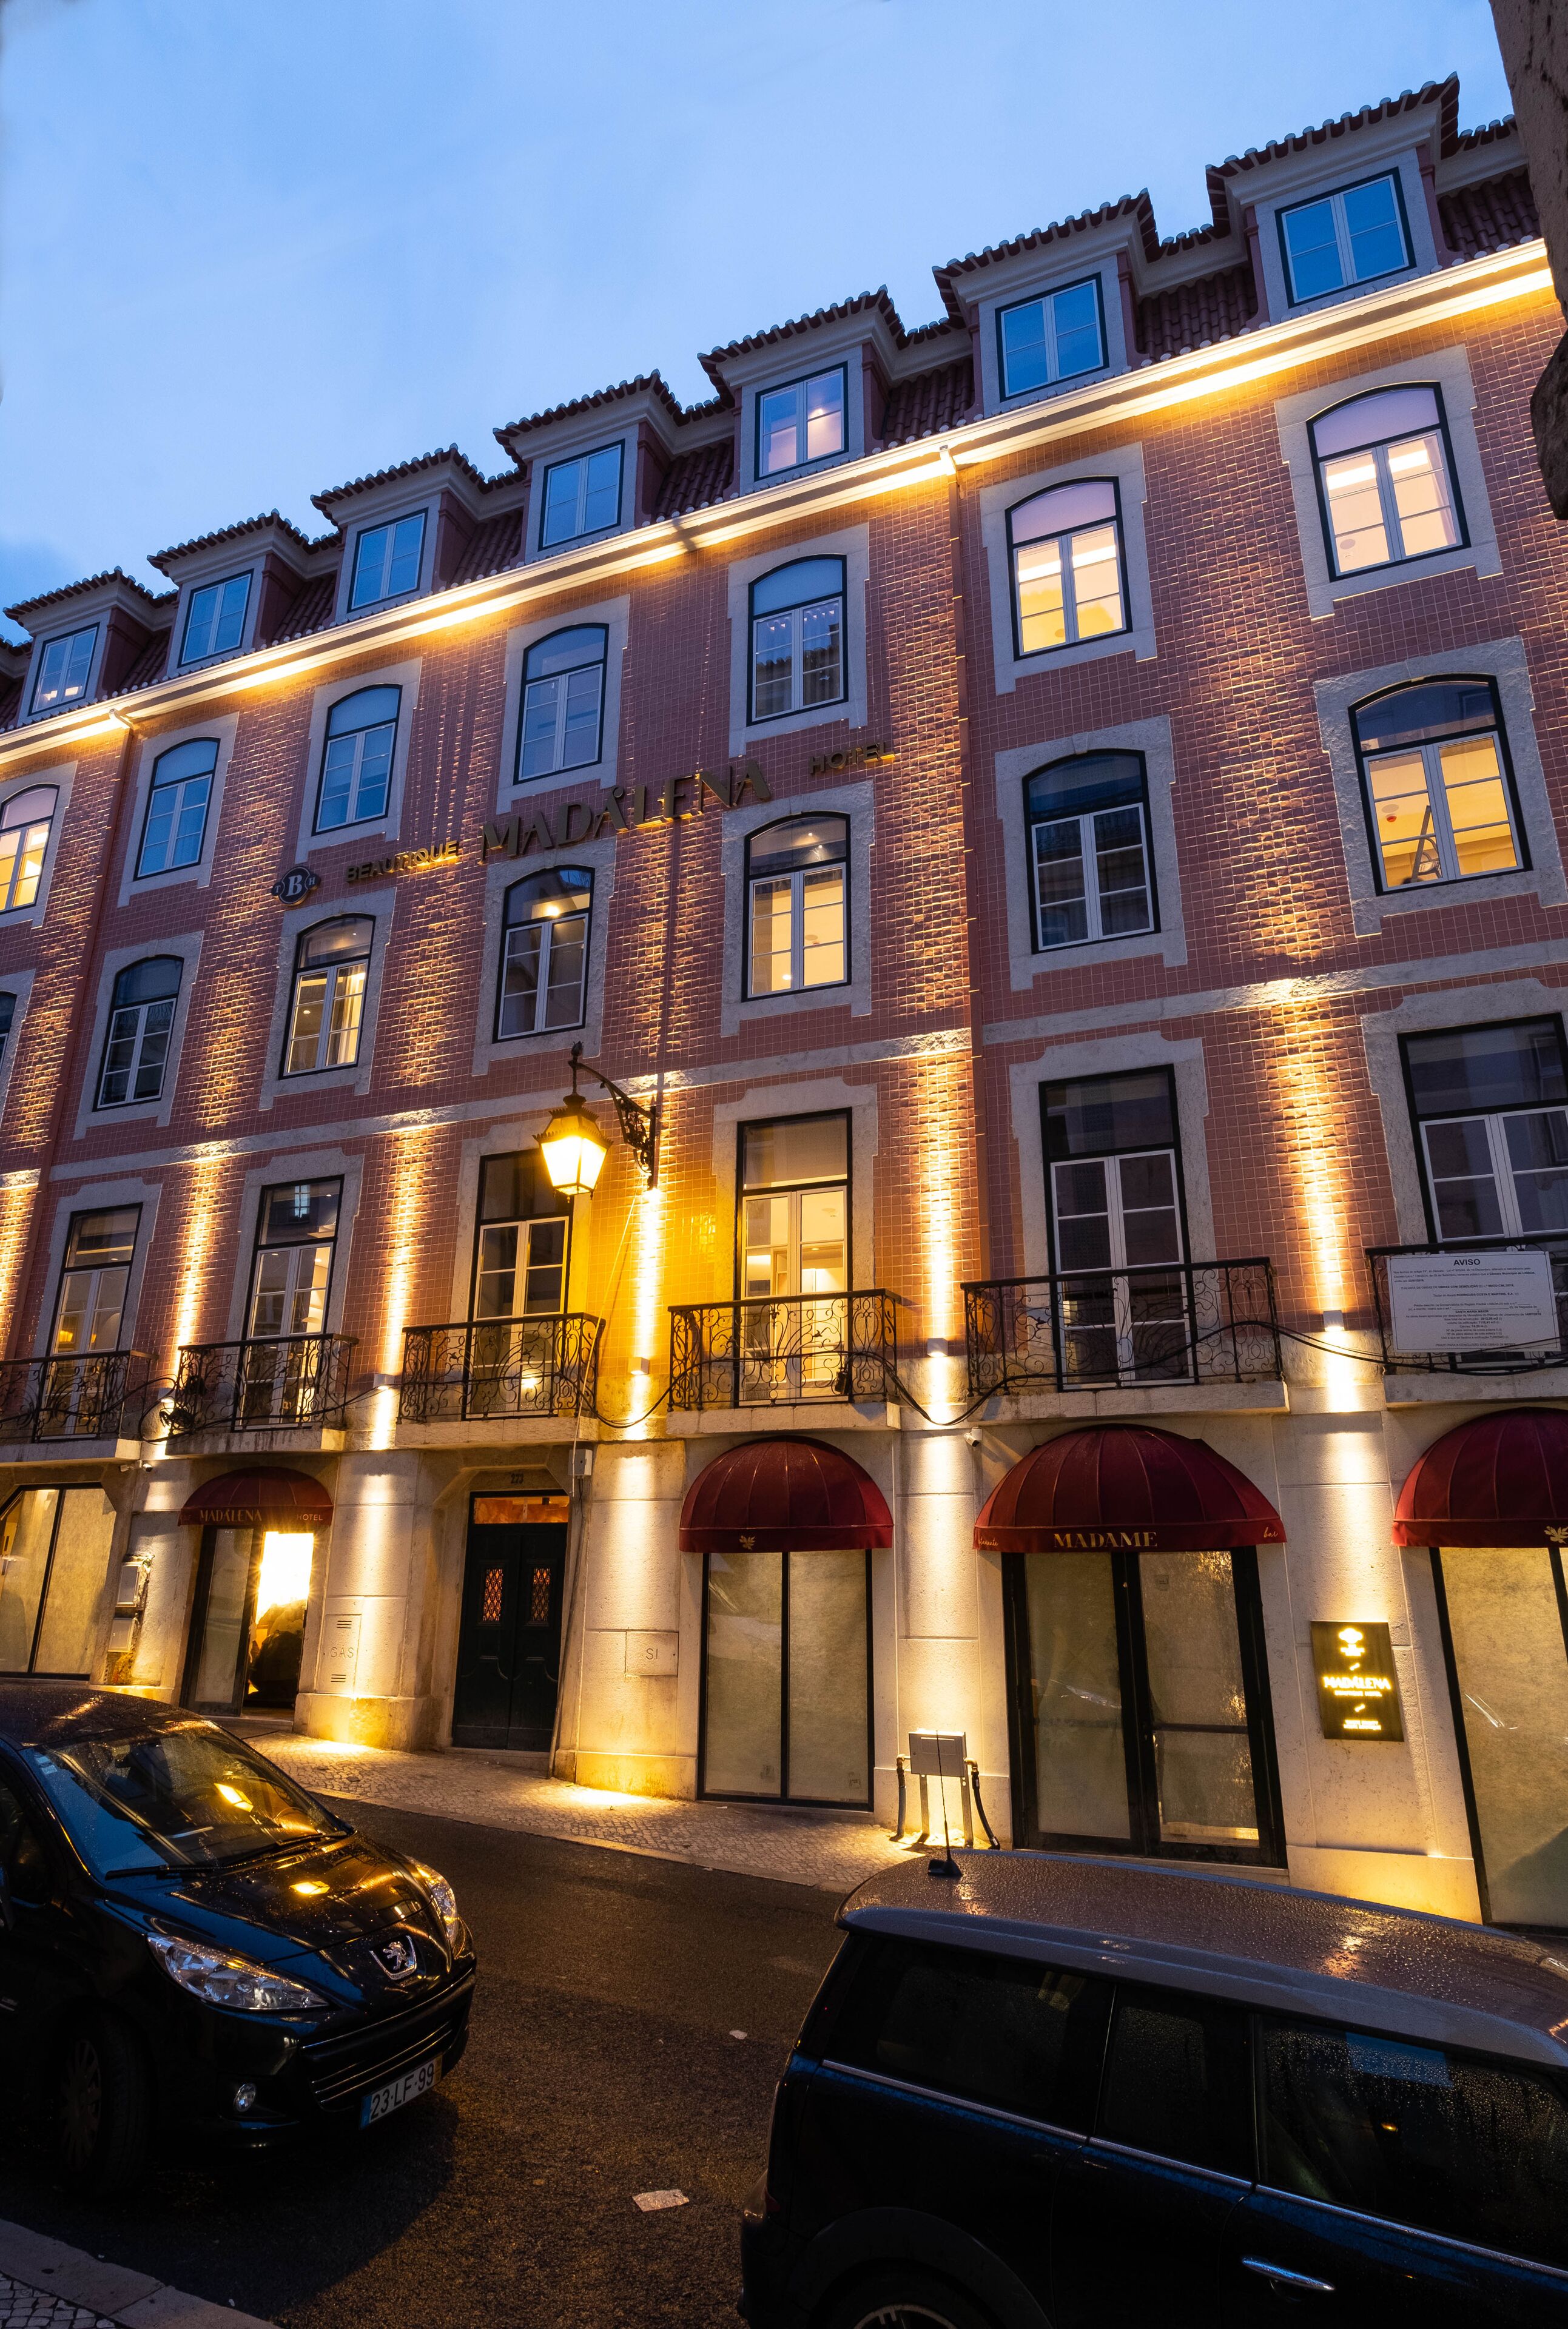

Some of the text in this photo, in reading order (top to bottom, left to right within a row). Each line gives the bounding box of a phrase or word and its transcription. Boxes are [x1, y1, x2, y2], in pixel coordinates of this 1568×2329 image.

[809, 742, 895, 775] HOTEL
[346, 840, 459, 882] BEAUTIQUE
[1054, 1531, 1158, 1548] MADAME
[1263, 1527, 1279, 1538] bar
